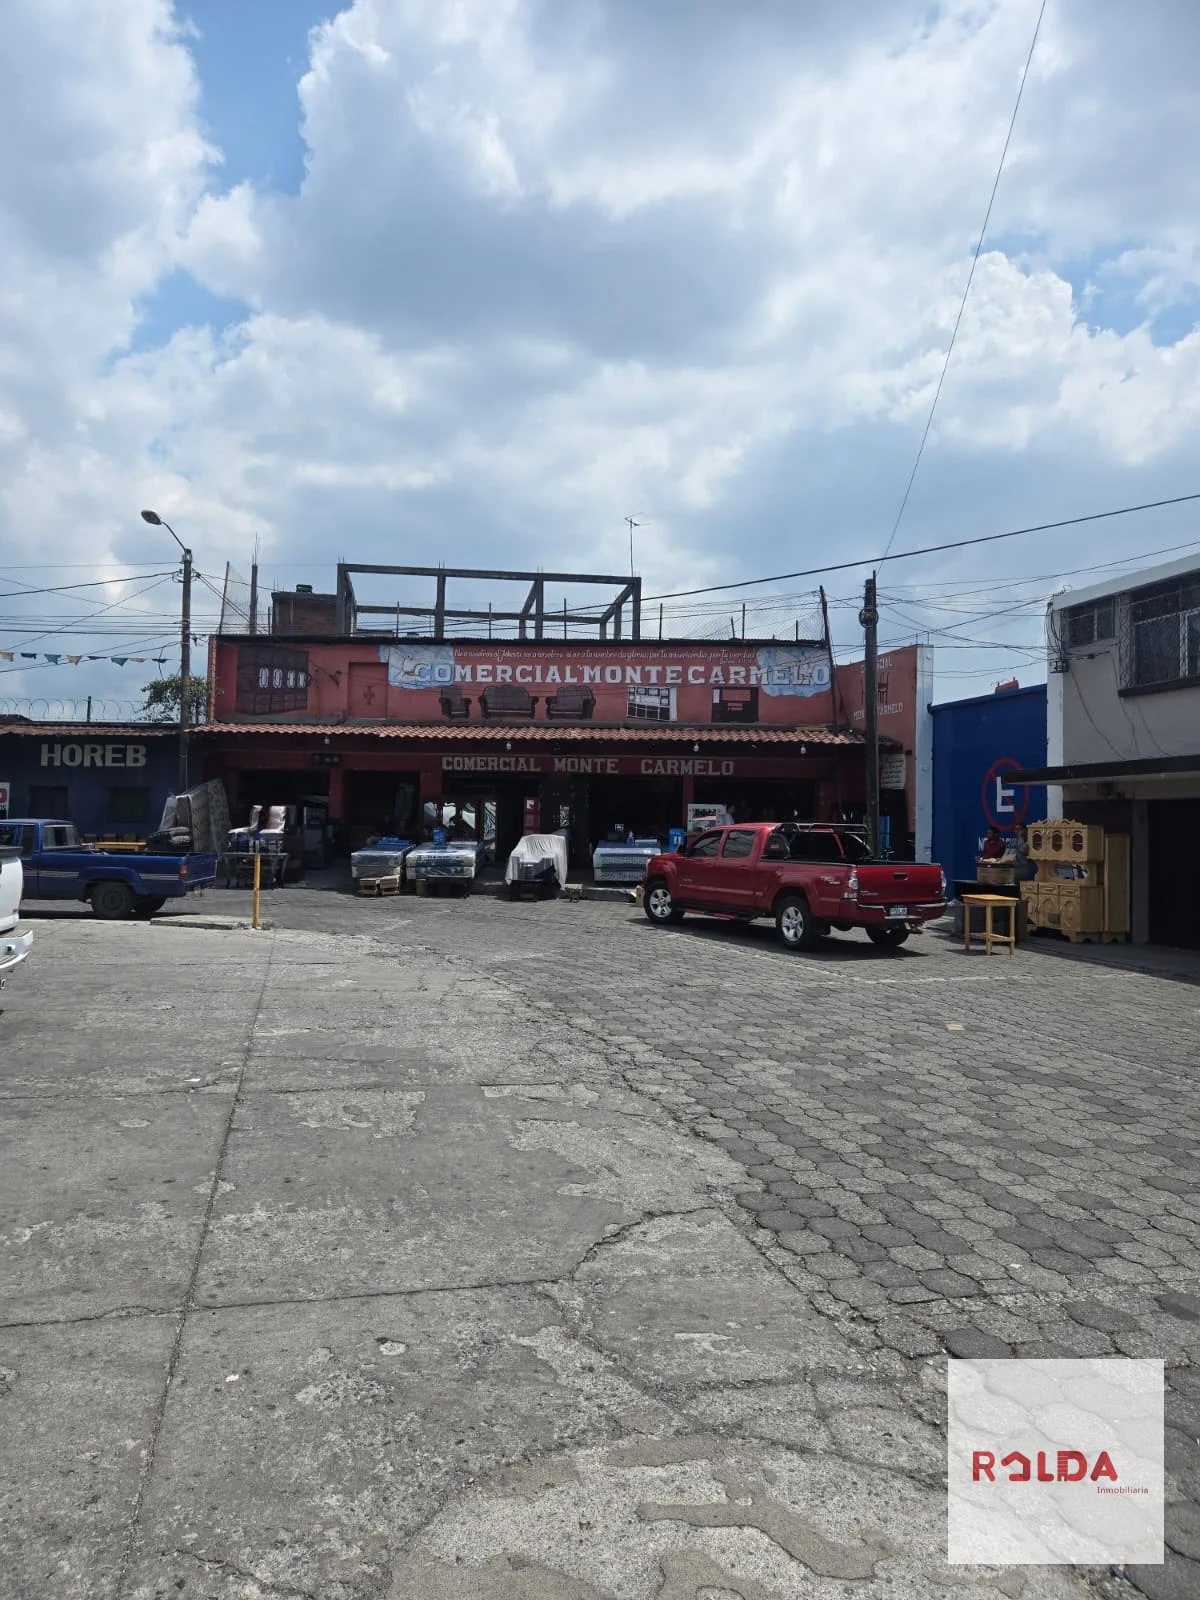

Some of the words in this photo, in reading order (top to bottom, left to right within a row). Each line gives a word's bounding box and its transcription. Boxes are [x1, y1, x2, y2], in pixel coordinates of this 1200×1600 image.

[414, 664, 578, 683] COMERCIAL
[687, 665, 830, 685] CARMELO
[40, 744, 147, 767] HOREB
[441, 756, 541, 772] COMERCIAL
[553, 758, 619, 774] MONTE
[641, 759, 734, 776] CARMELO
